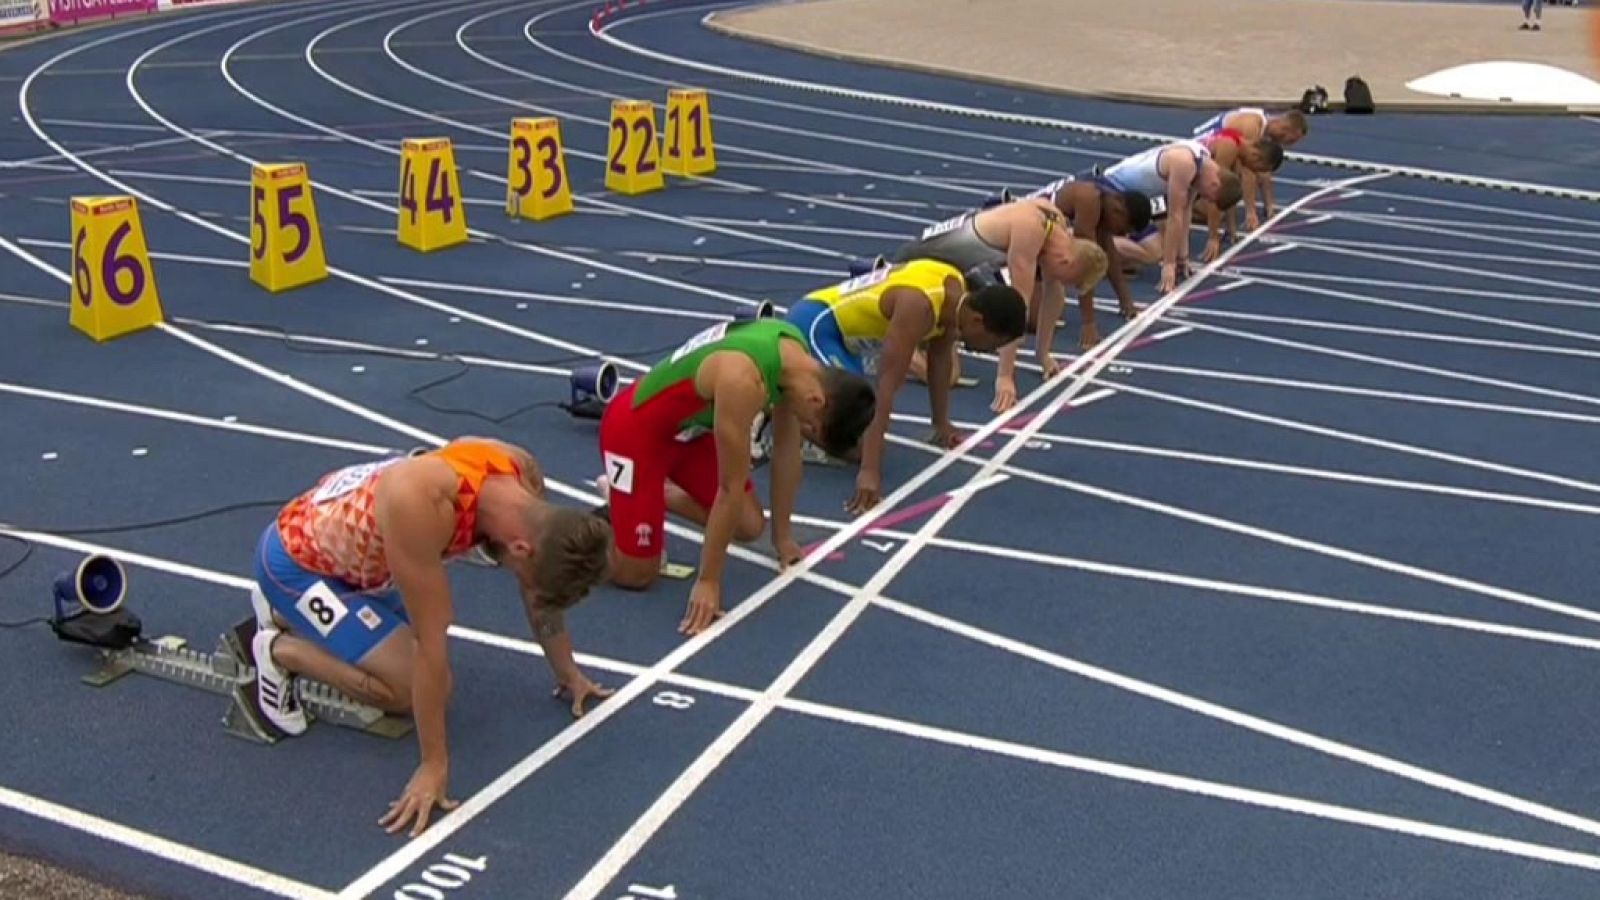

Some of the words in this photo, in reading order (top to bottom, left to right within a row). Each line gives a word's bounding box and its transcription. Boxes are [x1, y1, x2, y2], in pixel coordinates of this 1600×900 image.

[102, 220, 145, 306] 6
[612, 460, 625, 484] 7
[860, 539, 894, 552] 7
[308, 597, 334, 625] 8
[652, 691, 696, 709] 8
